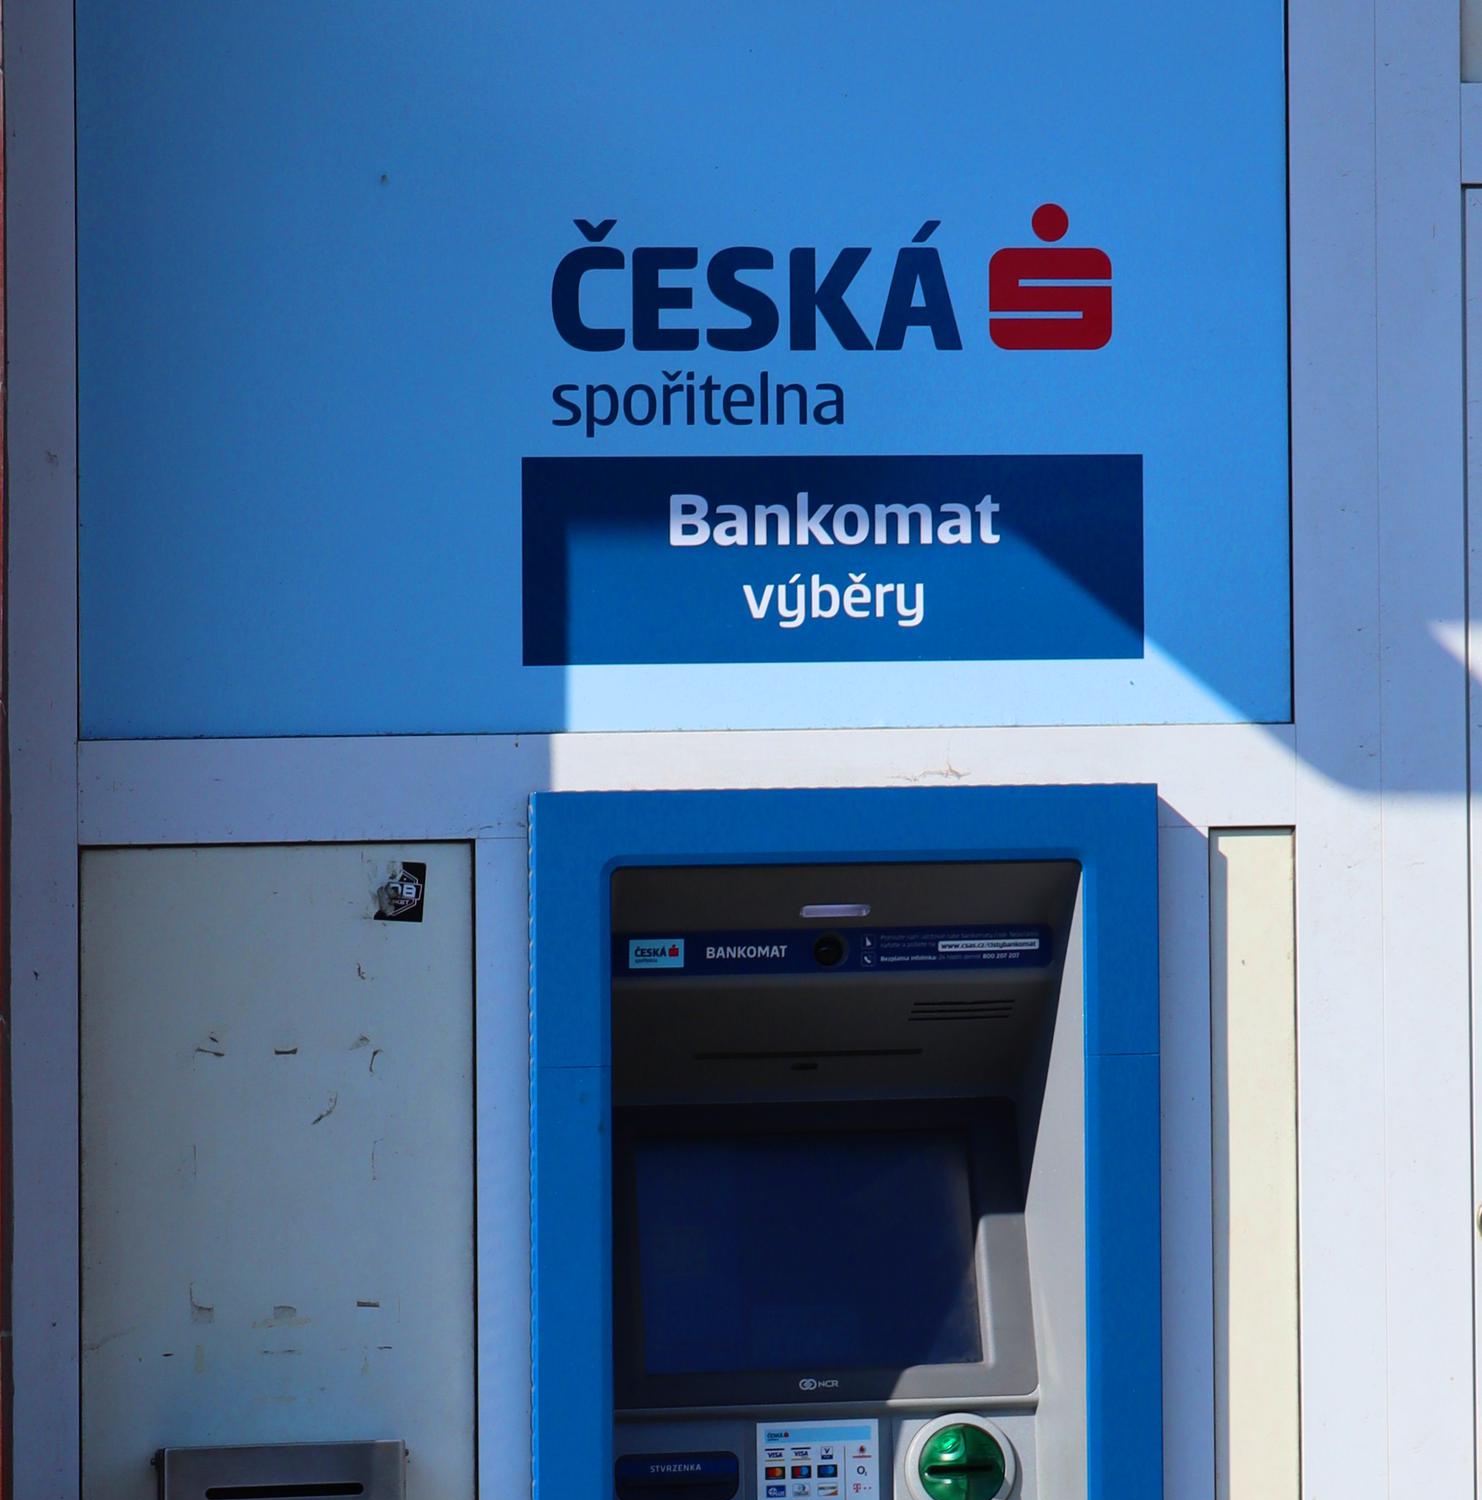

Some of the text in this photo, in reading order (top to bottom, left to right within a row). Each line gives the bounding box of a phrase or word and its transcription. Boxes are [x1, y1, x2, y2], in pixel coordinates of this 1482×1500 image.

[551, 219, 963, 352] ČESKÁ
[552, 370, 845, 437] spořitelna
[669, 492, 1000, 547] Bankomat
[743, 572, 925, 628] výběry
[634, 945, 667, 958] ČESKÁ
[706, 945, 787, 959] BANKOMAT
[818, 1380, 839, 1388] NCR
[650, 1463, 702, 1473] STVRZENKA
